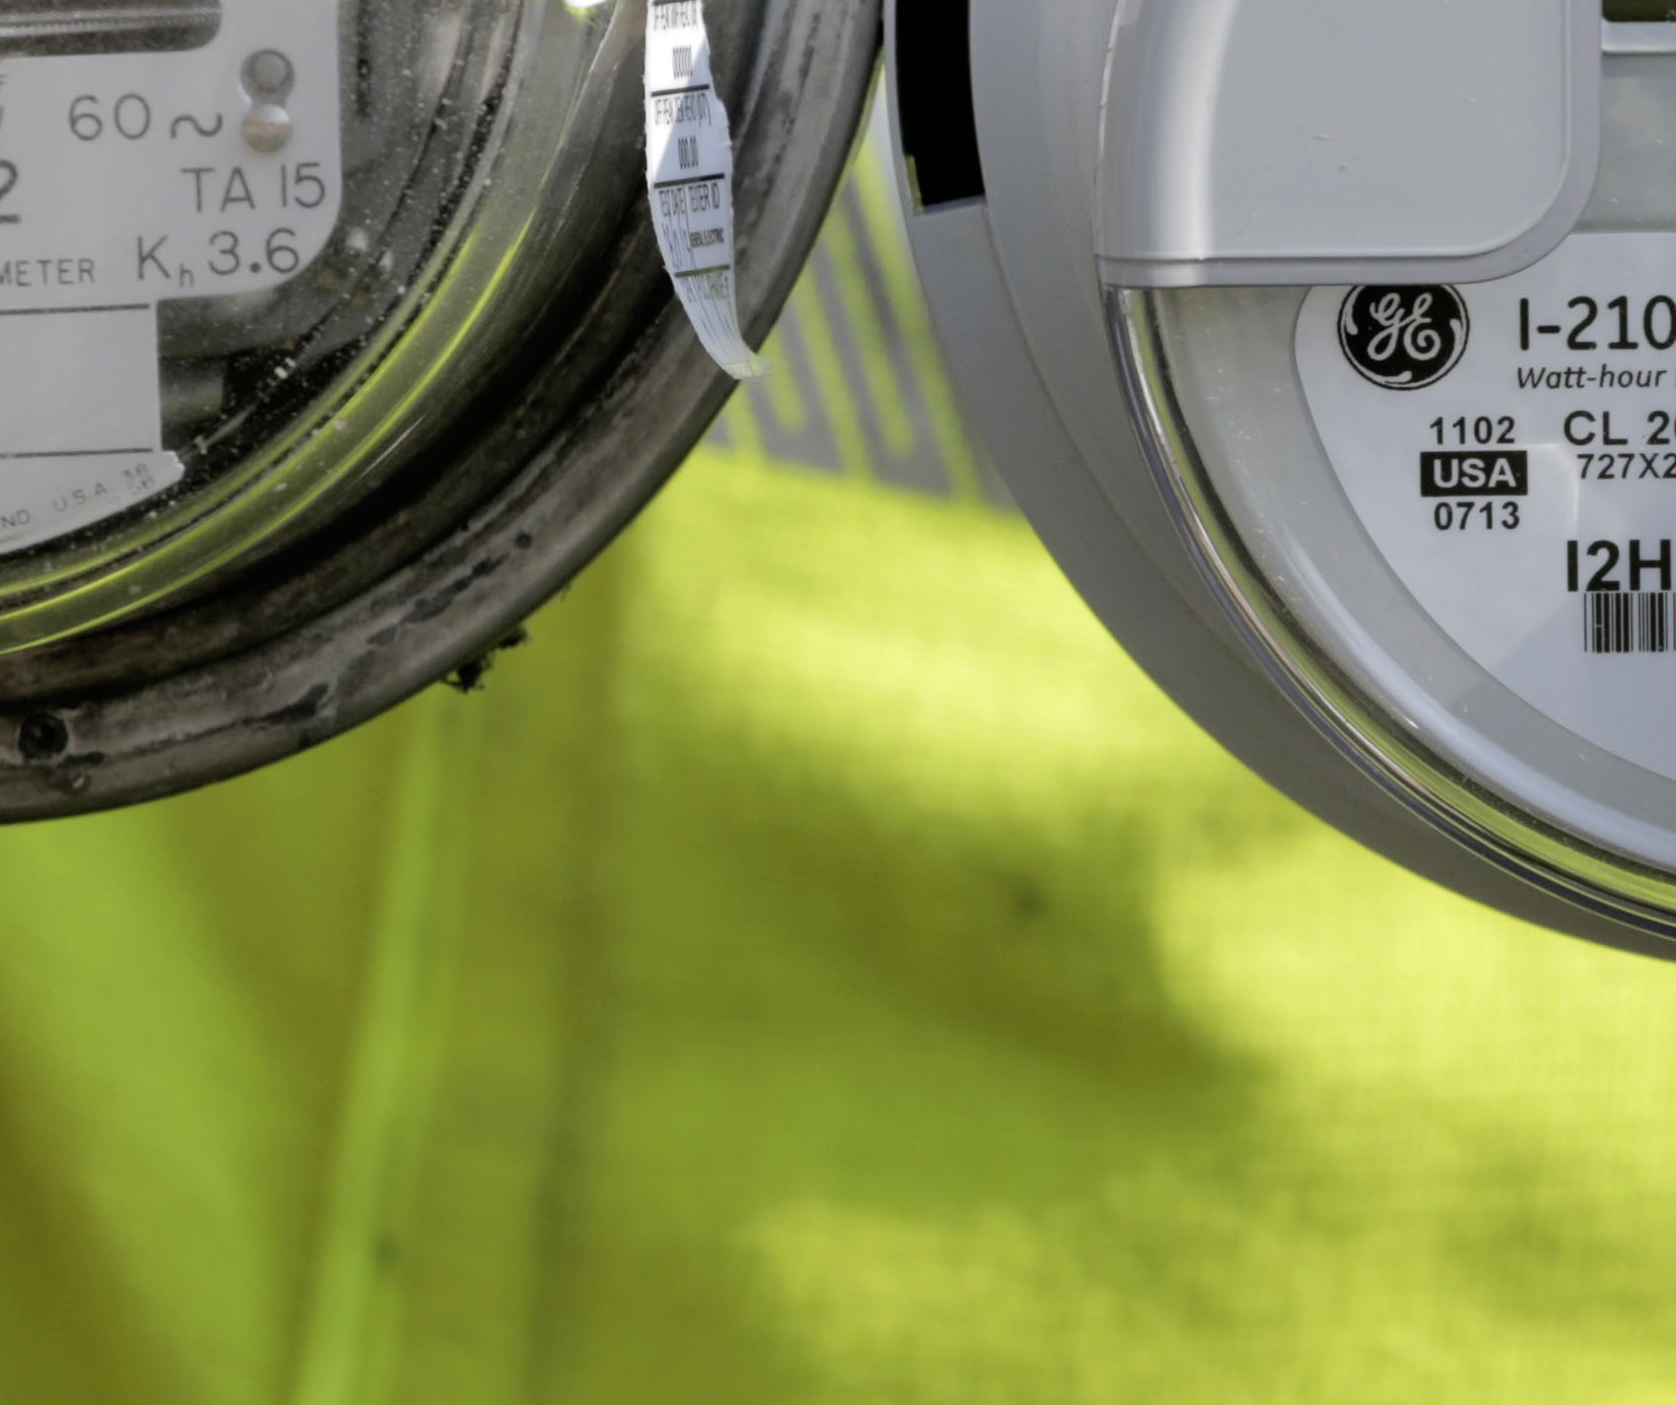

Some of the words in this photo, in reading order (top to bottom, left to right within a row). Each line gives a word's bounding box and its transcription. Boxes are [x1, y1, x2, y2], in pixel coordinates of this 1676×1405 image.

[69, 92, 150, 141] 60
[180, 166, 255, 214] TA
[281, 161, 327, 209] 15
[136, 234, 196, 289] Kh
[209, 227, 301, 277] 3.6
[1517, 365, 1668, 389] Watt-hour
[1429, 417, 1516, 445] 1102
[1563, 410, 1628, 446] CL
[1432, 458, 1517, 488] USA
[1433, 501, 1521, 530] 0713
